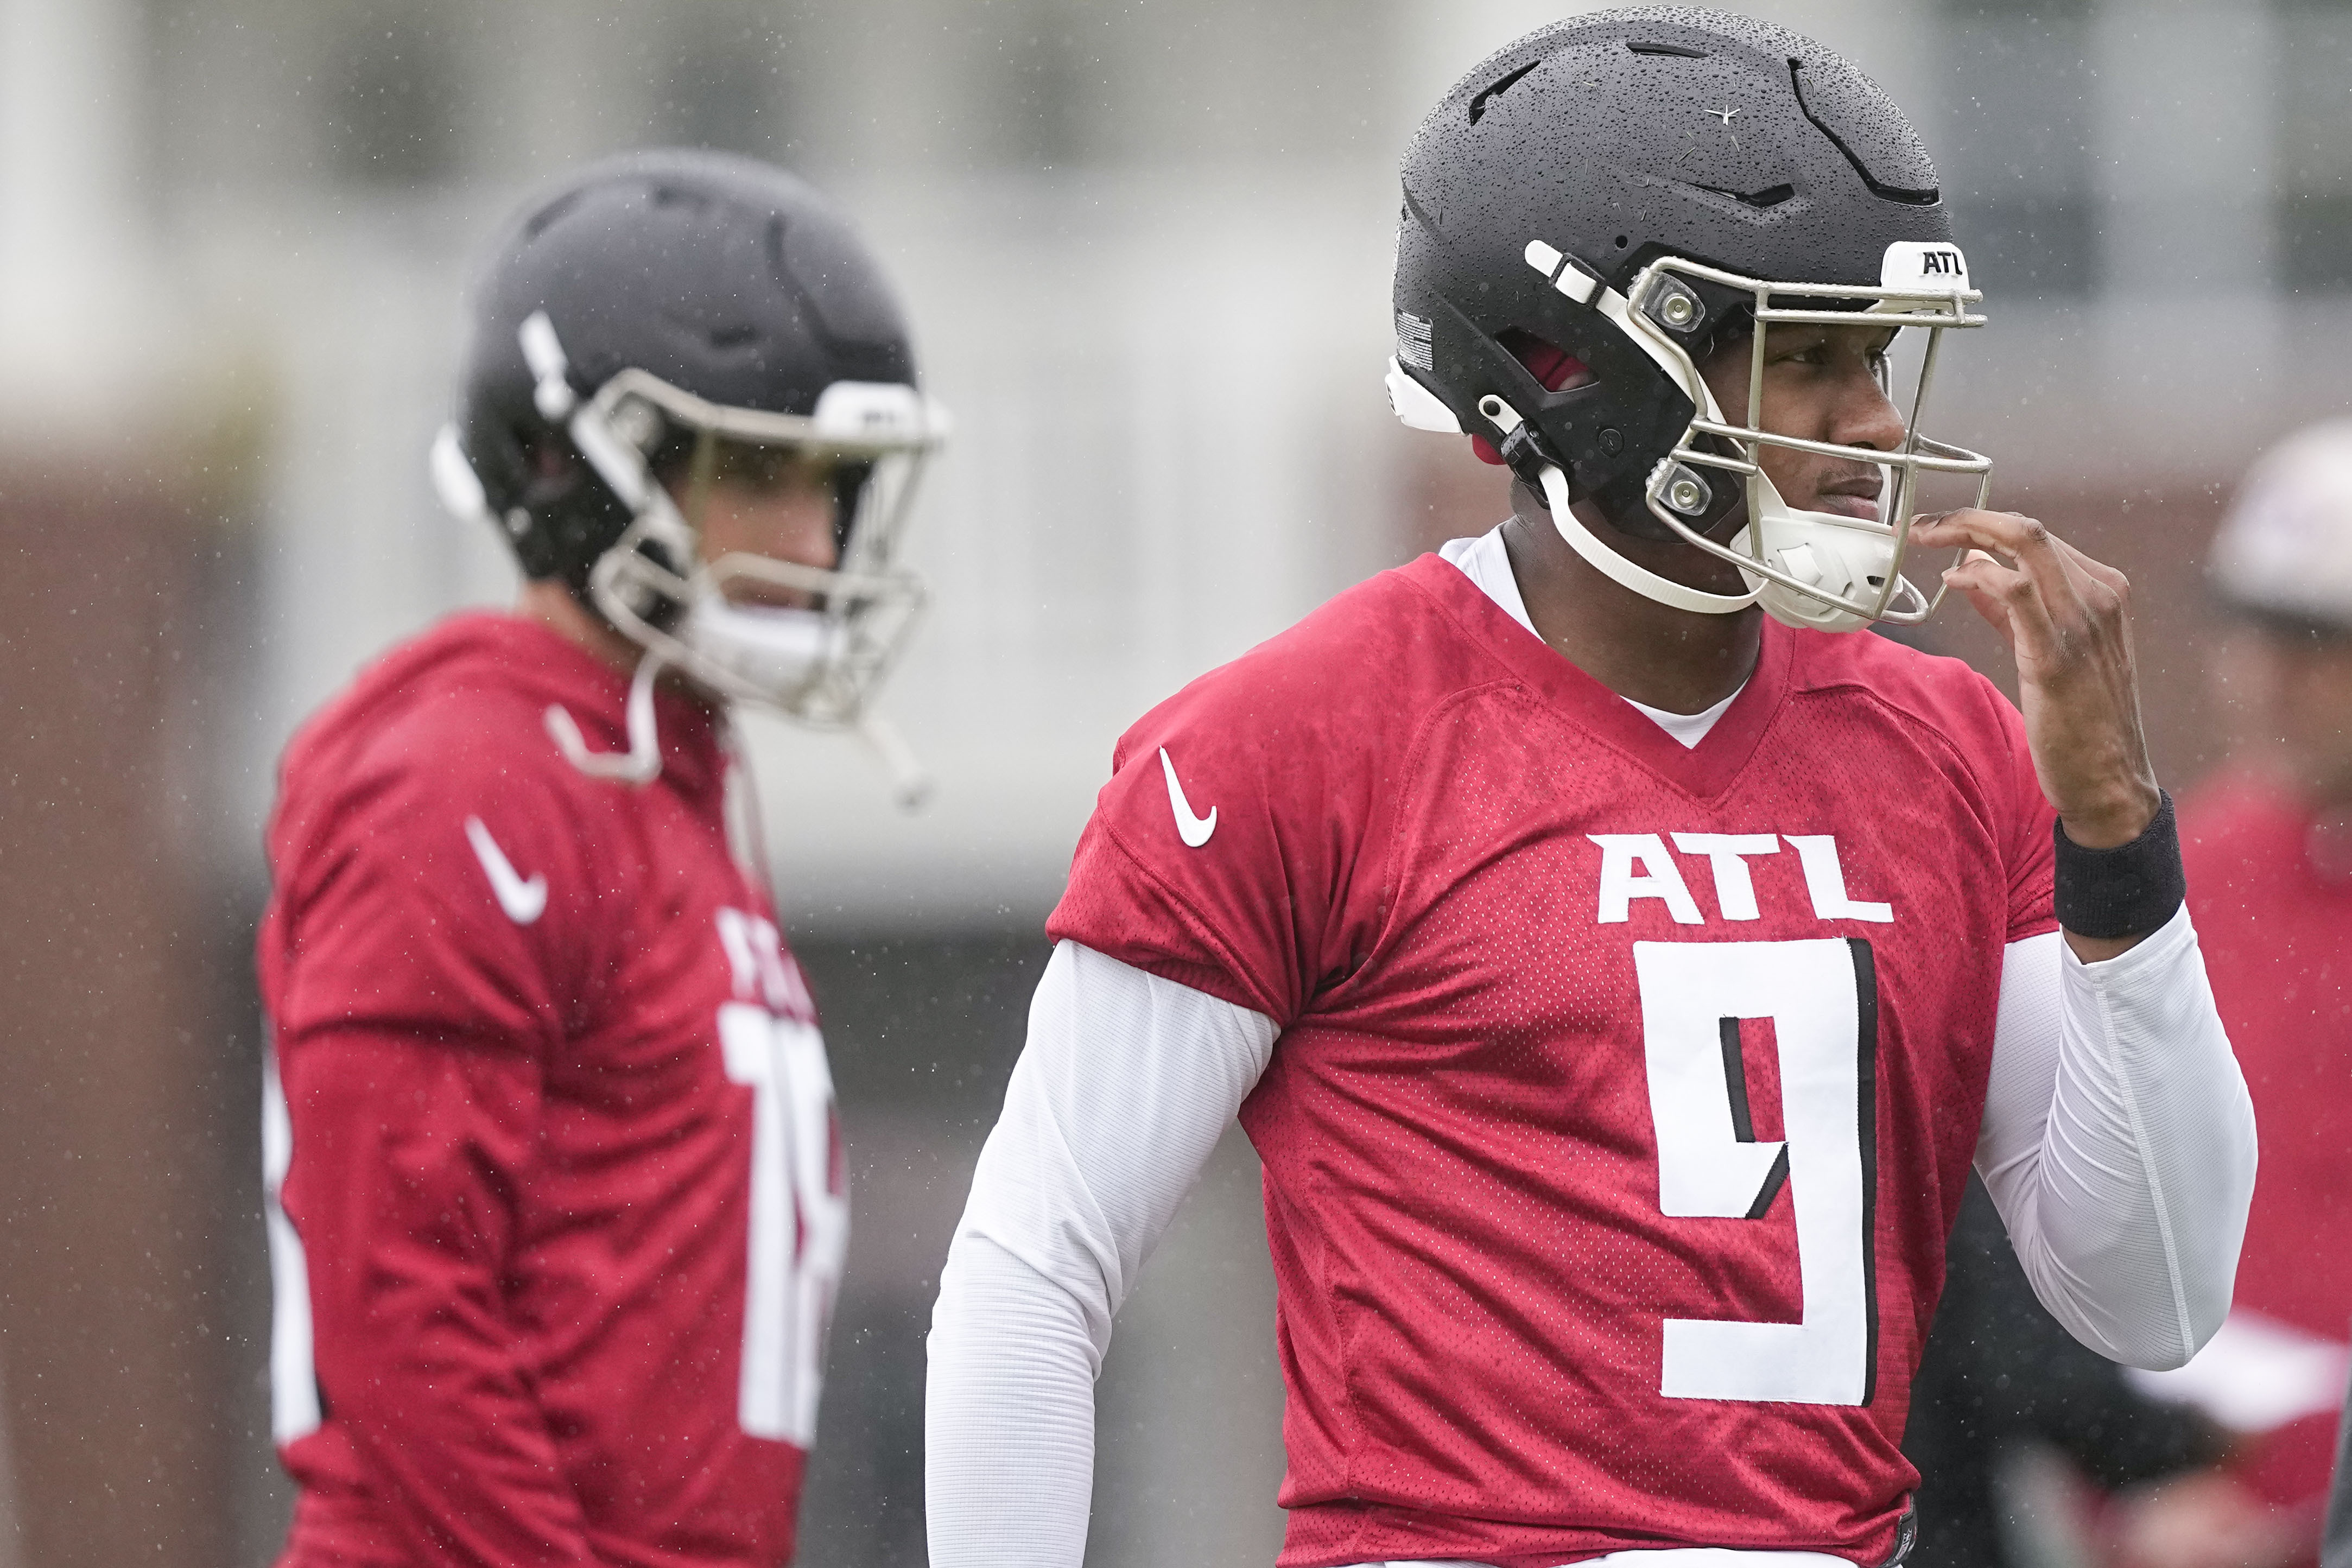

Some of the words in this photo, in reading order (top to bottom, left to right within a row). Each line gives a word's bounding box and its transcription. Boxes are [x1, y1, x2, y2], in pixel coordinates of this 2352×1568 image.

[1923, 250, 1963, 275] ATL
[1585, 831, 1894, 925] ATL
[1632, 934, 1879, 1408] 9
